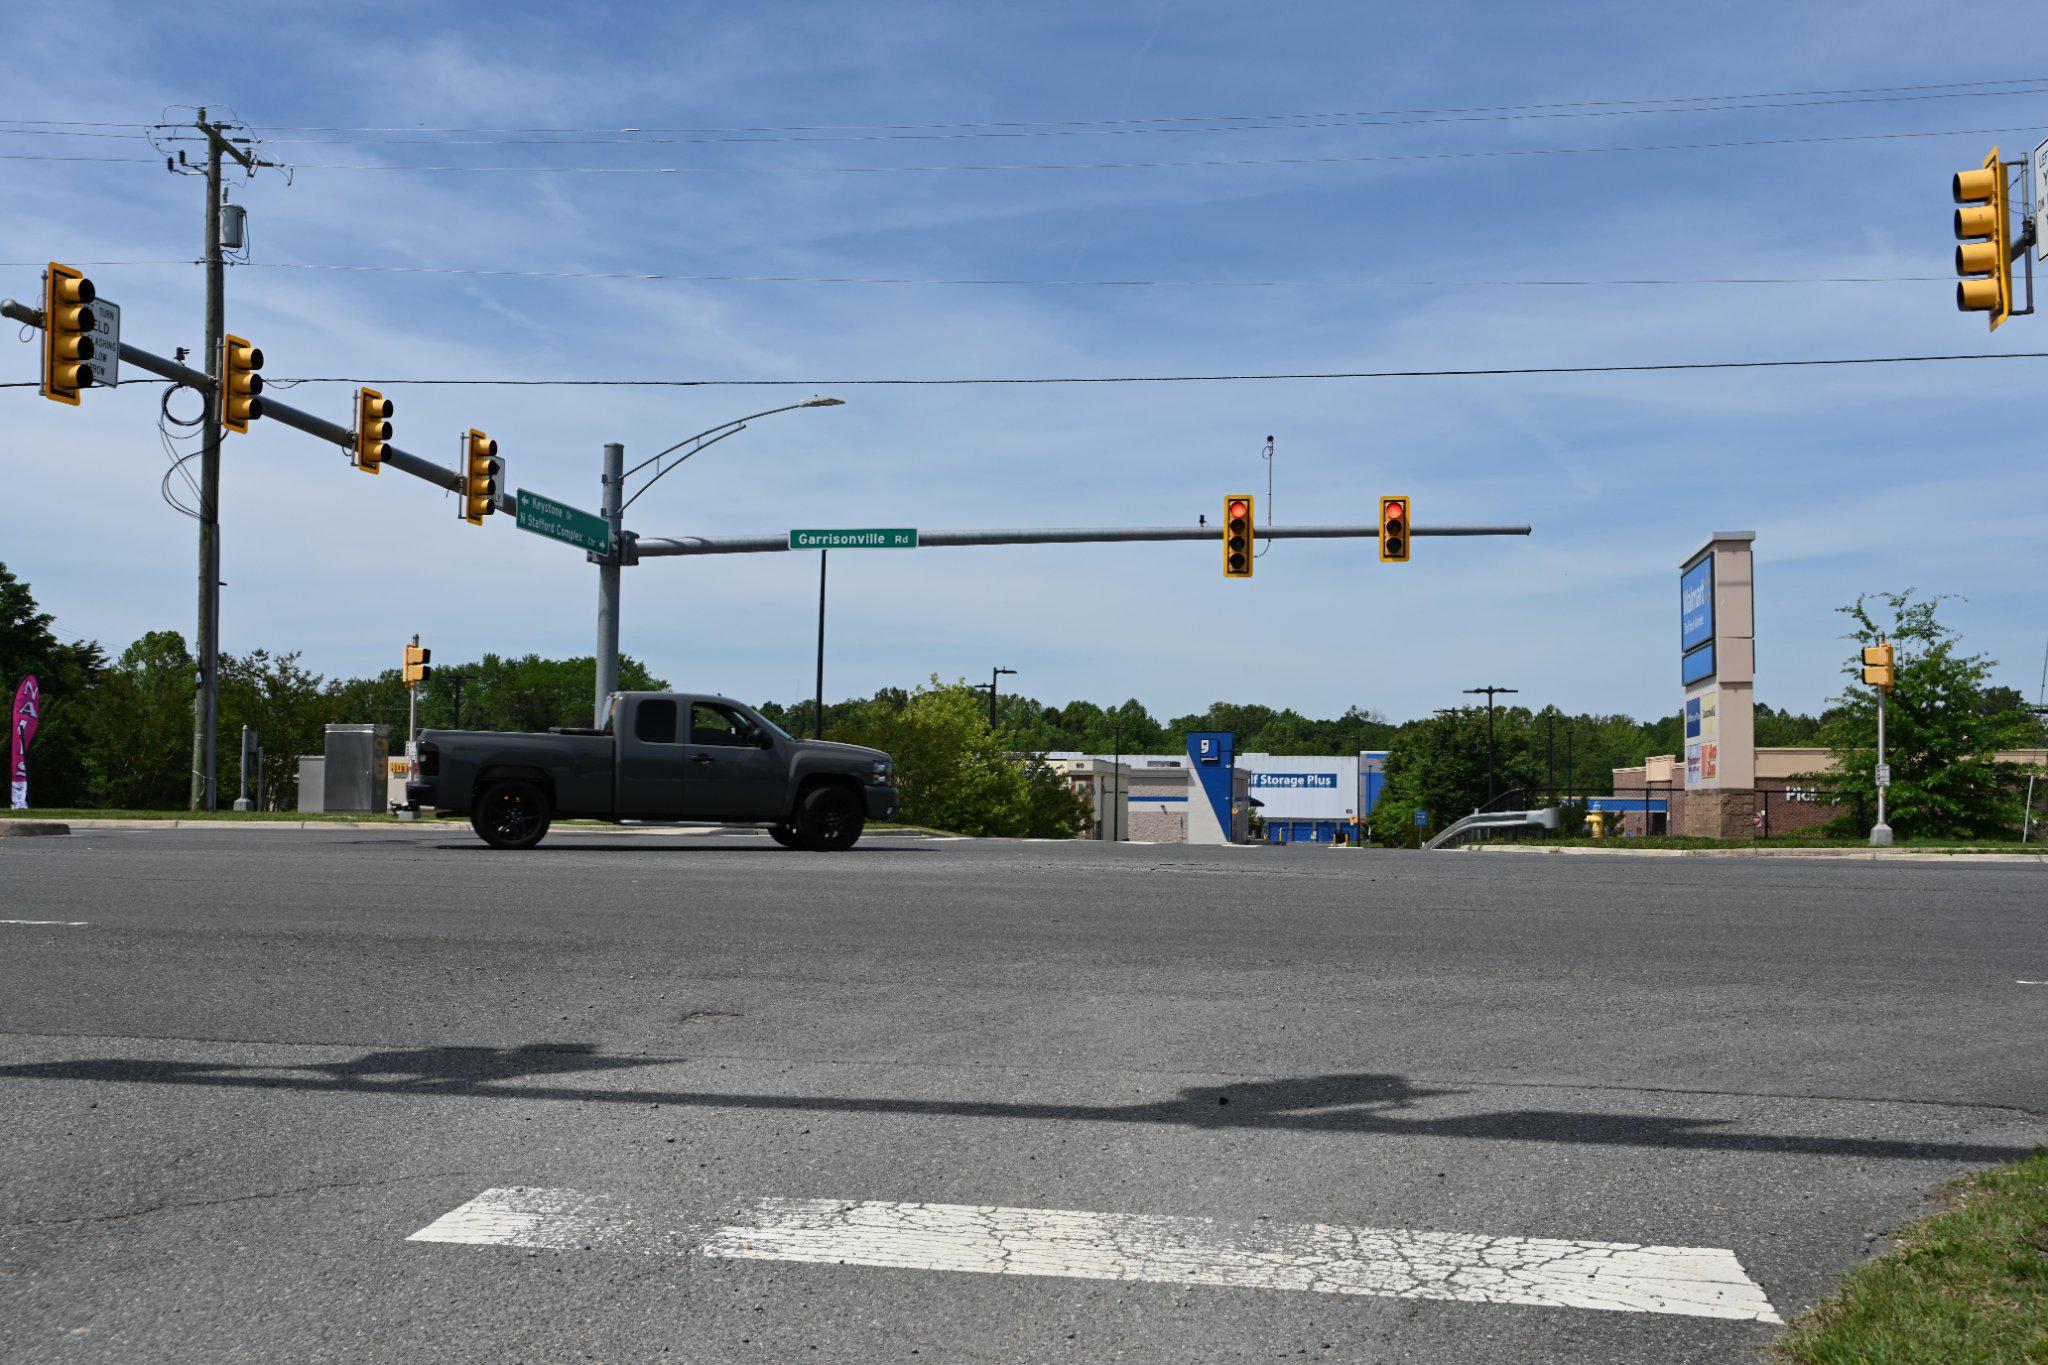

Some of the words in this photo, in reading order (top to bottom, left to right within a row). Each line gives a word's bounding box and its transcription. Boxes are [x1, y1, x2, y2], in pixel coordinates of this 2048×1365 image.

[99, 307, 114, 320] TURN
[94, 319, 110, 334] ELD
[94, 337, 116, 352] ASHING
[532, 497, 563, 518] Keystone
[566, 511, 572, 520] Dr
[520, 512, 526, 524] N
[528, 514, 554, 534] Stafford
[556, 524, 583, 543] Complex
[798, 534, 886, 544] Garrisonville
[895, 535, 909, 544] Rd
[1260, 774, 1304, 788] Storage
[1307, 774, 1331, 786] Plus
